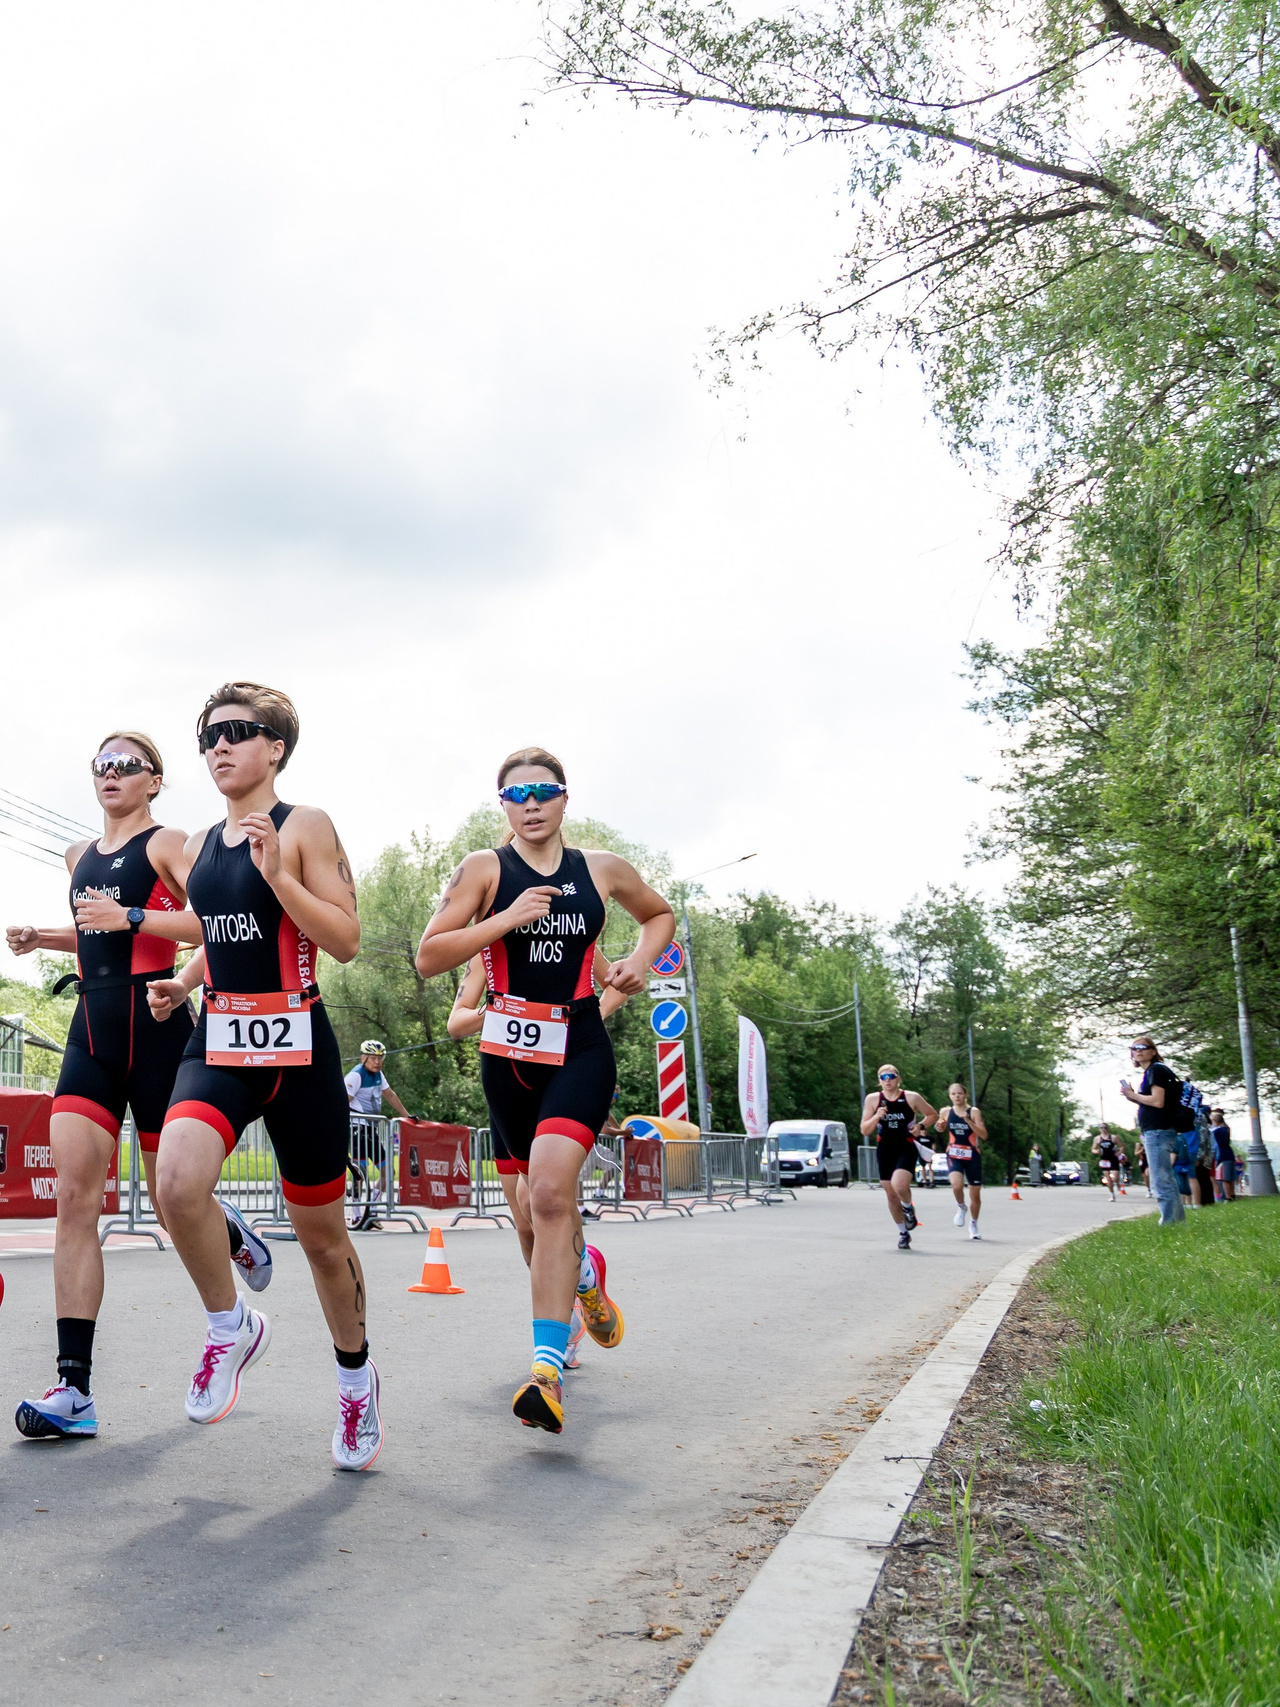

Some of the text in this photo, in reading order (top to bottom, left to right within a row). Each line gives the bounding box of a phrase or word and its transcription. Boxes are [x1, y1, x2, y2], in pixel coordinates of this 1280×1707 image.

[202, 912, 263, 943] ТИТОВА
[529, 940, 564, 963] MOS
[228, 1018, 293, 1048] 102
[506, 1019, 541, 1047] 99
